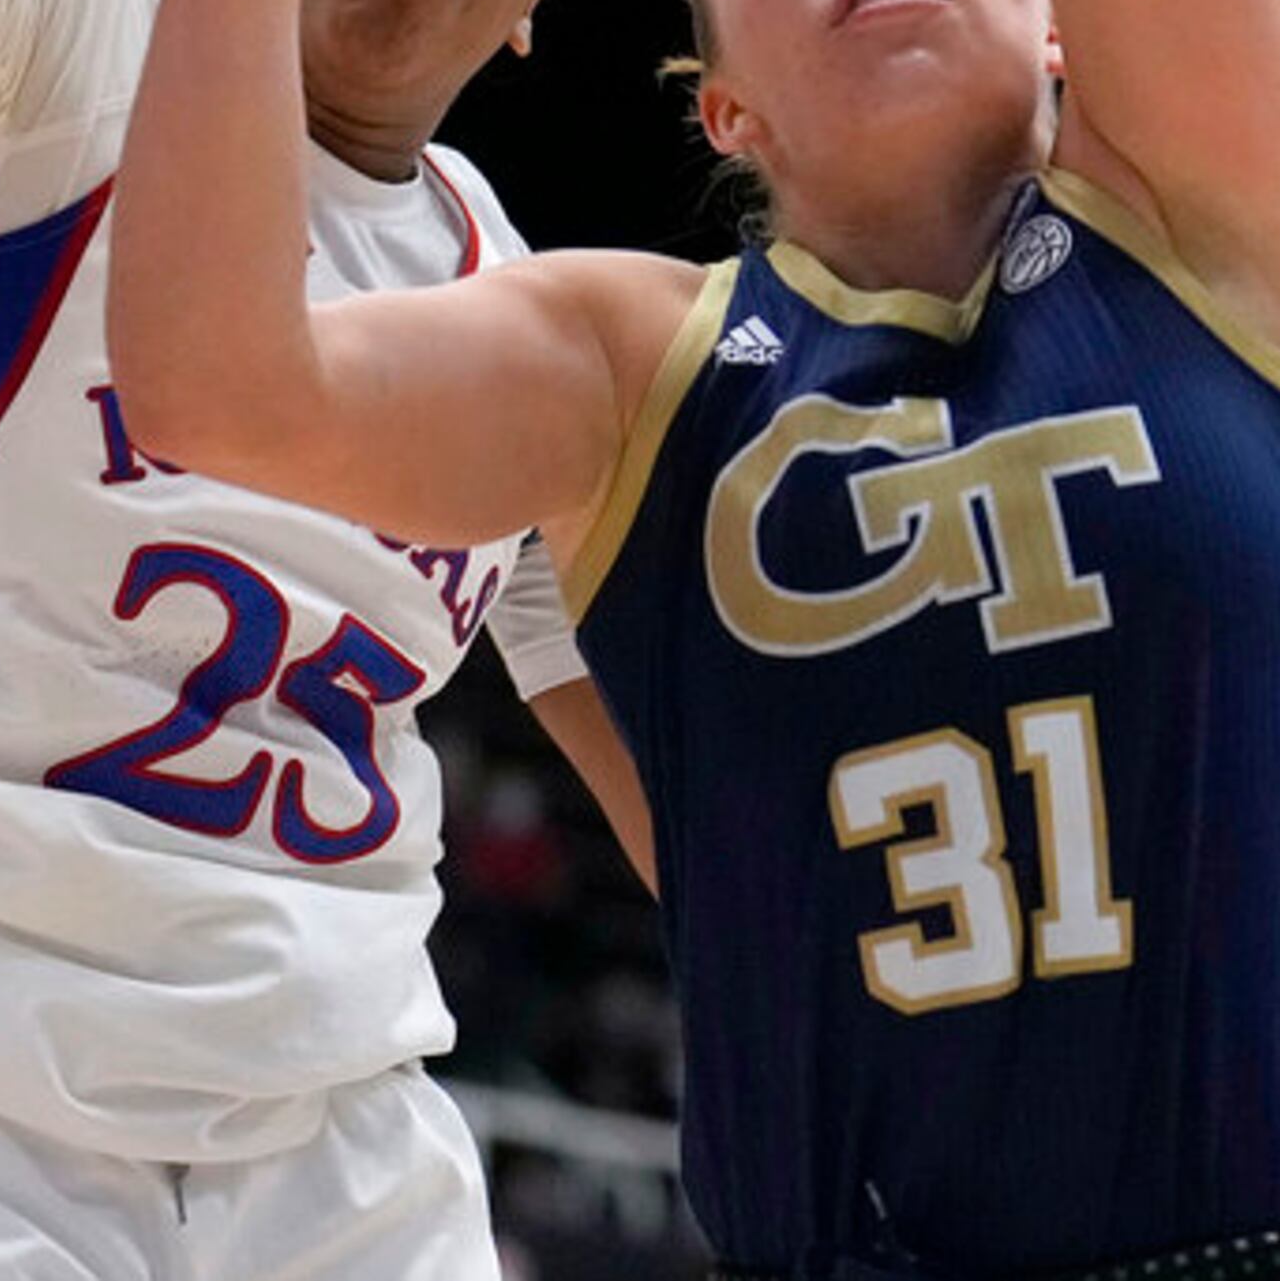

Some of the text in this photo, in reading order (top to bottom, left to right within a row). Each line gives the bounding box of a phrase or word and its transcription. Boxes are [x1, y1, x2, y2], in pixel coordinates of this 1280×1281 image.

[715, 345, 784, 365] dids
[704, 392, 1162, 657] GT
[43, 542, 427, 866] 25
[827, 694, 1134, 1016] 31
